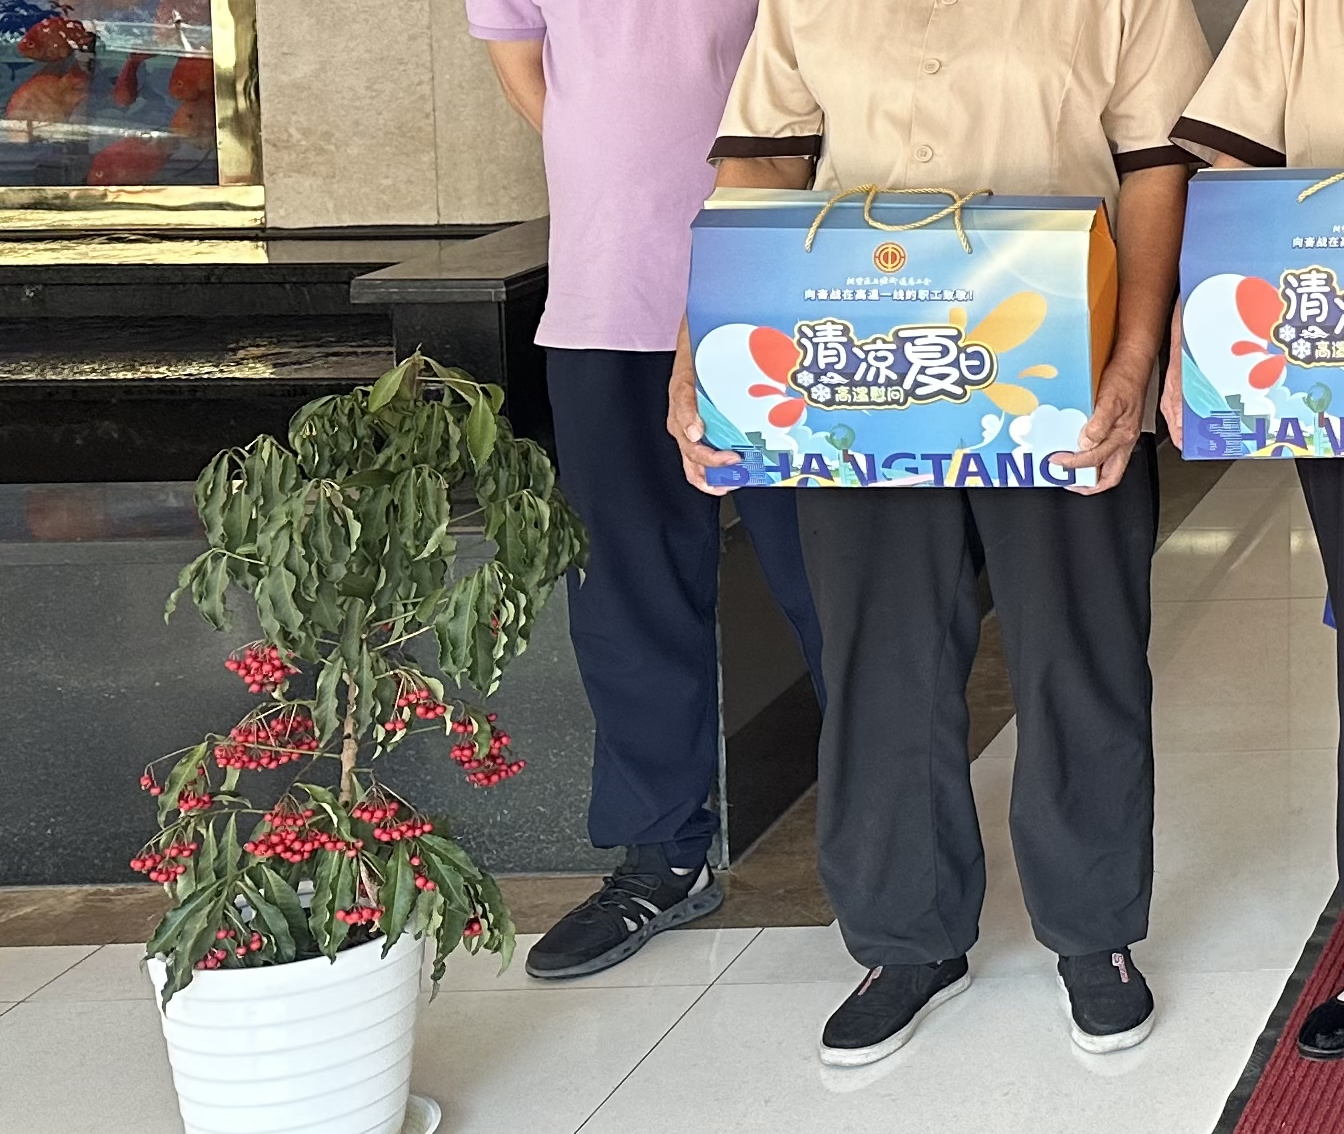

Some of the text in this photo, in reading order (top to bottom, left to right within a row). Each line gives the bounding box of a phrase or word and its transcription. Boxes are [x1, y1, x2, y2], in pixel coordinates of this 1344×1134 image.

[800, 321, 992, 397] 清凉夏日
[834, 385, 905, 404] 高温慰问
